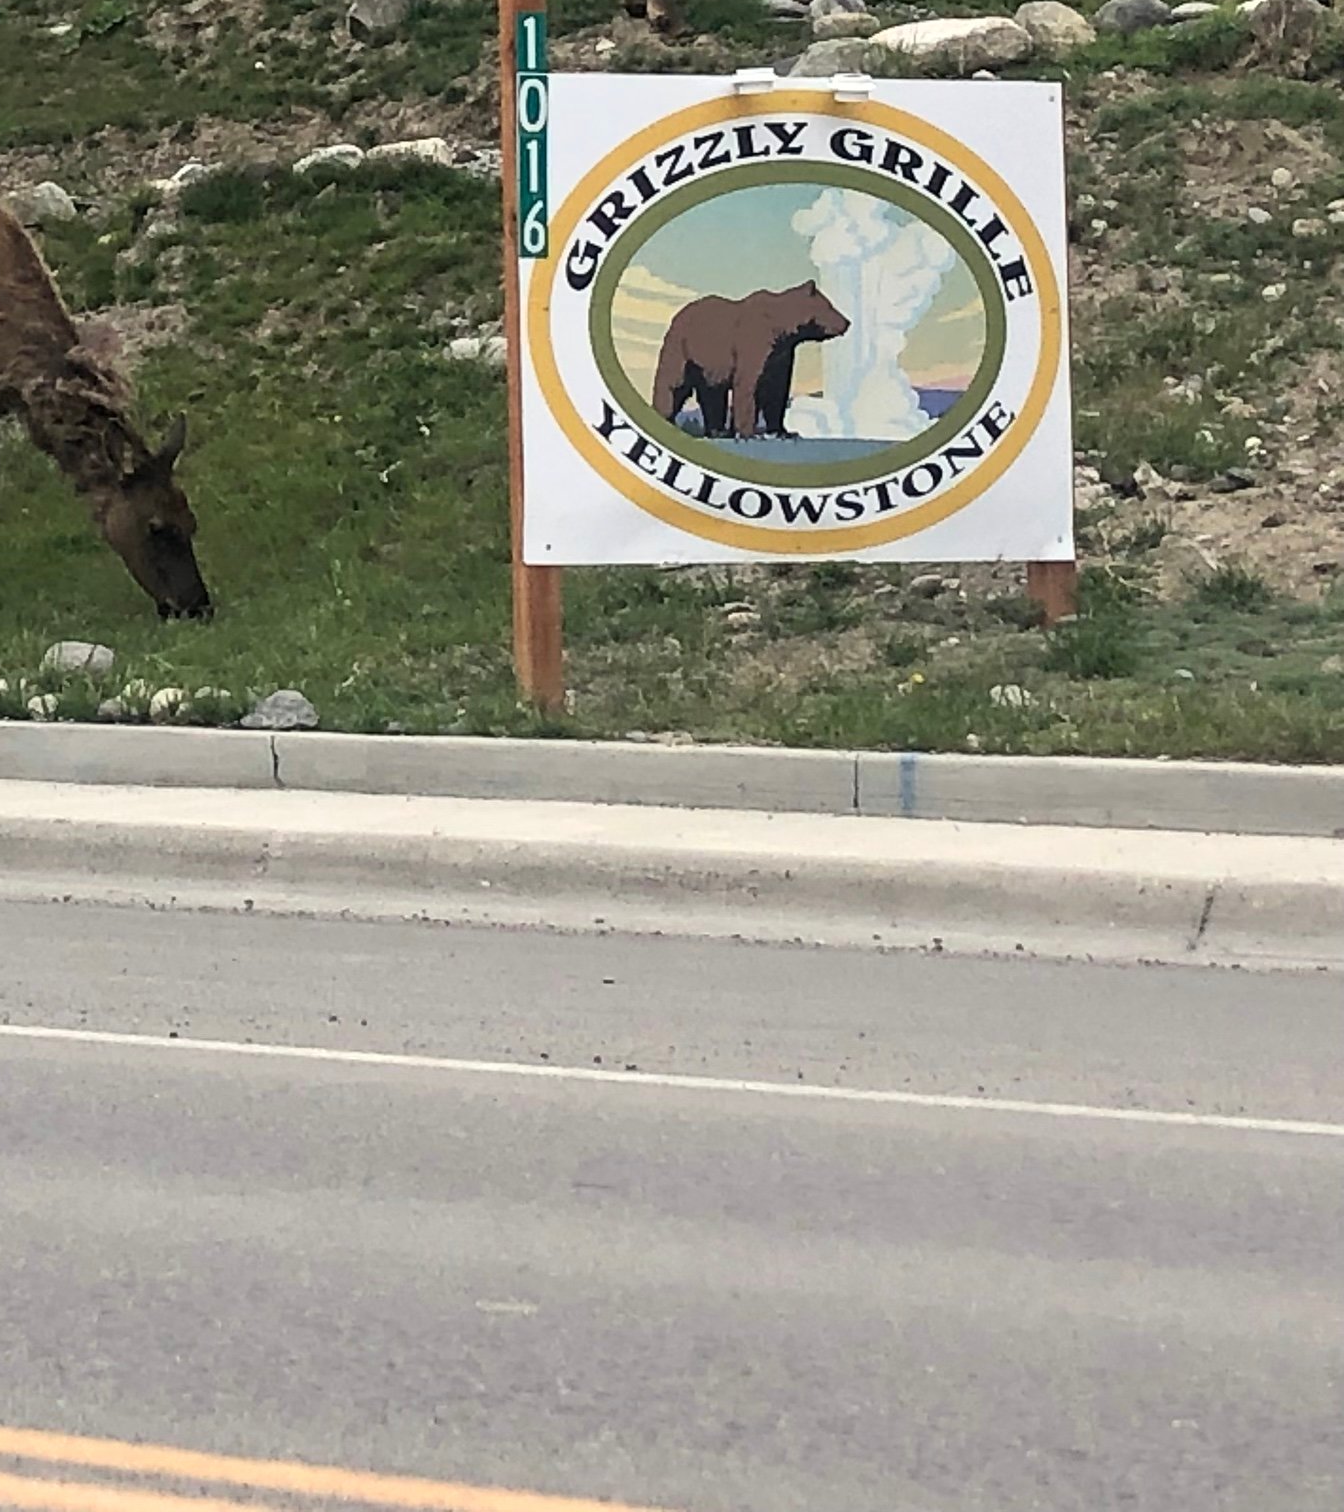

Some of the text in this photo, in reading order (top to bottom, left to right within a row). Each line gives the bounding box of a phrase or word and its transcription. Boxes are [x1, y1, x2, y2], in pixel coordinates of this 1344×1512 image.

[519, 15, 548, 254] 1016
[565, 122, 1034, 302] GRIZZLY GRILLE
[591, 399, 1016, 524] YELLOWSTONE
